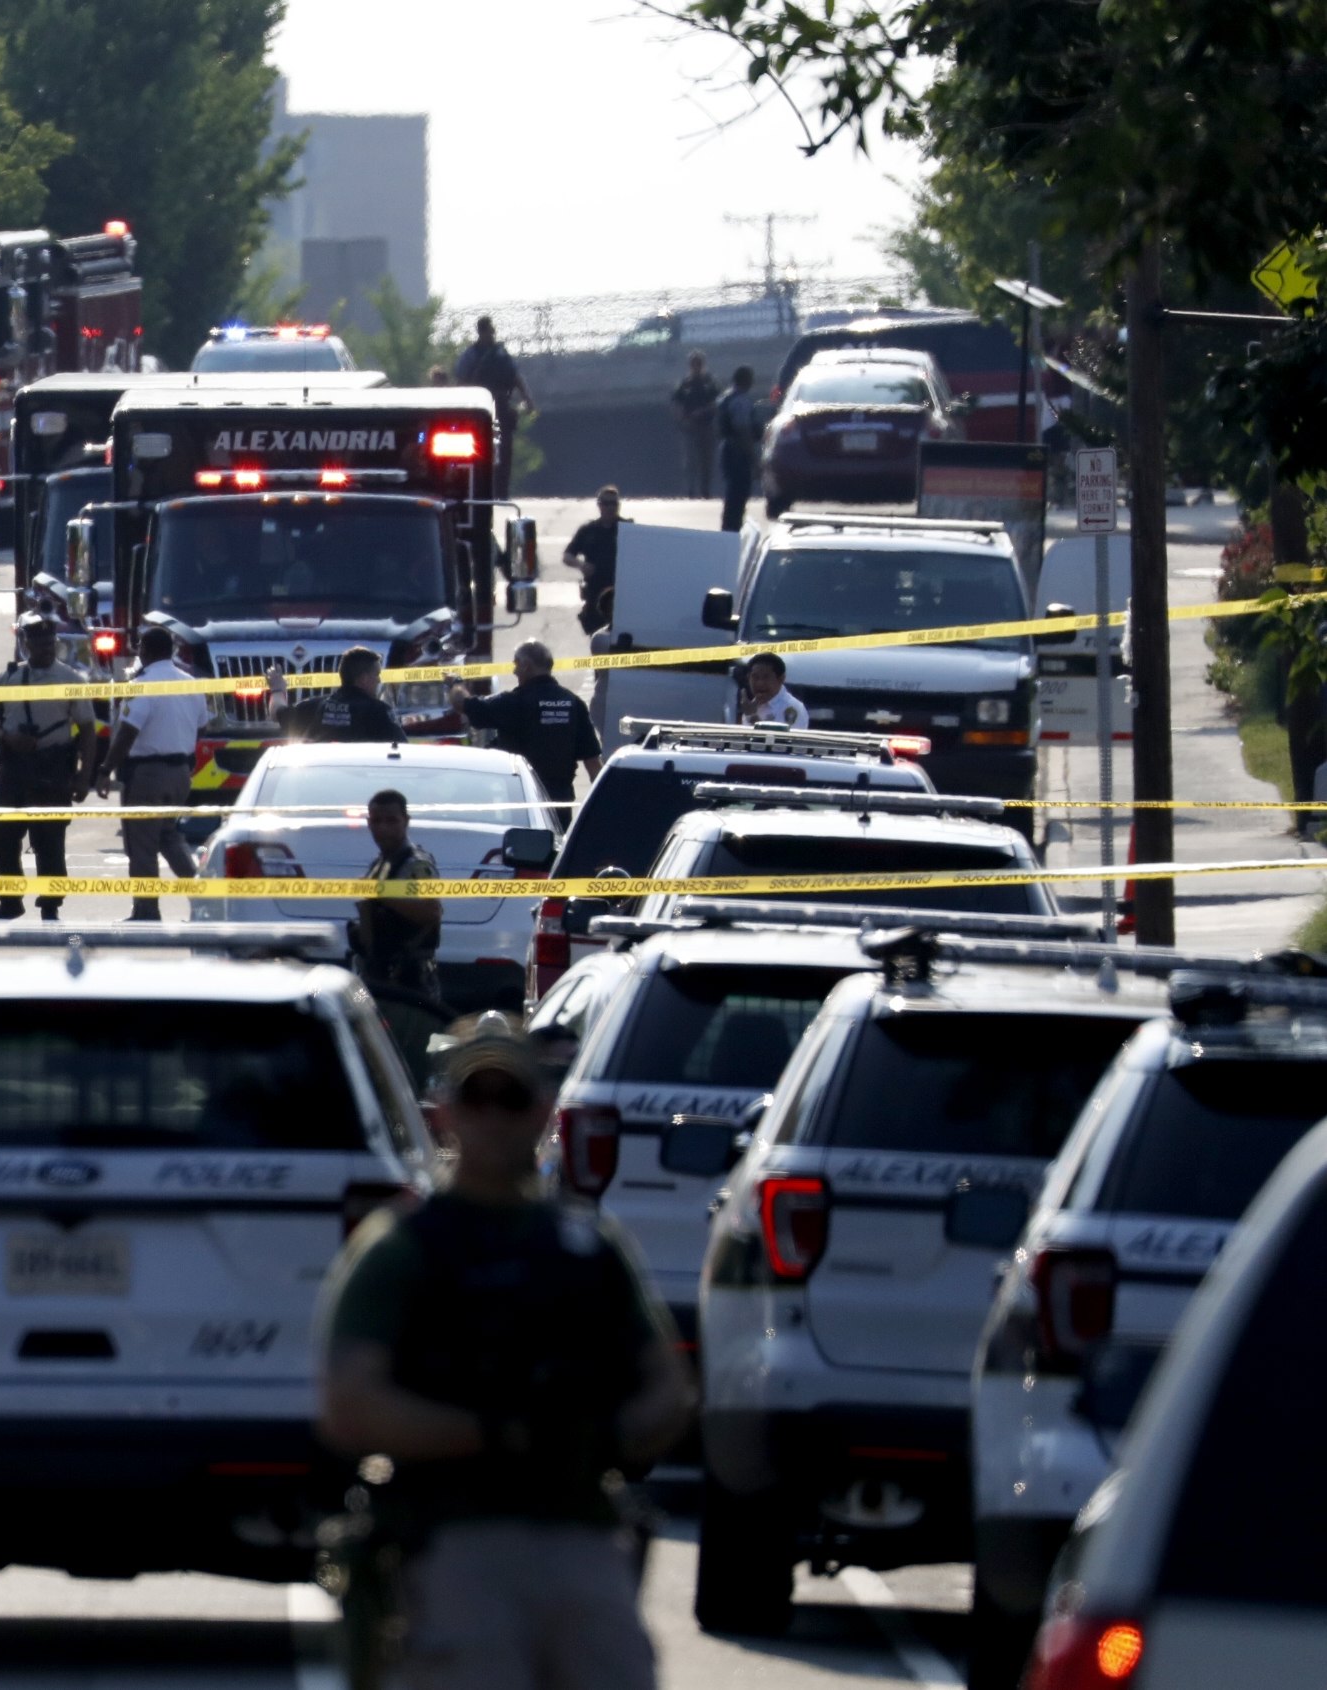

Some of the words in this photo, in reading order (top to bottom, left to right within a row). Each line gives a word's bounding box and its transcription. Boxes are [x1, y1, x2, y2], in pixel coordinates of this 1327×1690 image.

[214, 430, 396, 451] ALEXANDRIA
[1089, 458, 1102, 472] NO
[1080, 474, 1112, 488] PARKING
[1080, 489, 1099, 501] HERE
[1102, 488, 1113, 500] TO
[1083, 503, 1111, 515] CORNER
[48, 879, 87, 891] CROSS
[89, 879, 111, 891] NOT
[113, 879, 130, 891] DO
[628, 879, 652, 891] NOT
[652, 879, 669, 891] DO
[672, 878, 710, 891] SCENE
[712, 878, 749, 891] CRIME
[769, 878, 808, 889] CROSS
[809, 877, 833, 887] NOT
[835, 876, 853, 887] DO
[857, 875, 892, 886] SCENE
[893, 874, 932, 885] CRIME
[132, 880, 170, 892] SCENE
[171, 881, 207, 893] CRIME
[227, 880, 266, 893] CROSS
[268, 881, 289, 893] NOT
[291, 881, 308, 893] DO
[310, 881, 348, 894] SCENE
[405, 882, 444, 894] CROSS
[445, 882, 468, 894] NOT
[471, 882, 488, 894] DO
[491, 882, 527, 894] SCENE
[530, 881, 566, 893] CRIME
[586, 880, 626, 892] CROSS
[152, 1162, 293, 1188] POLICE
[189, 1320, 281, 1358] 1604
